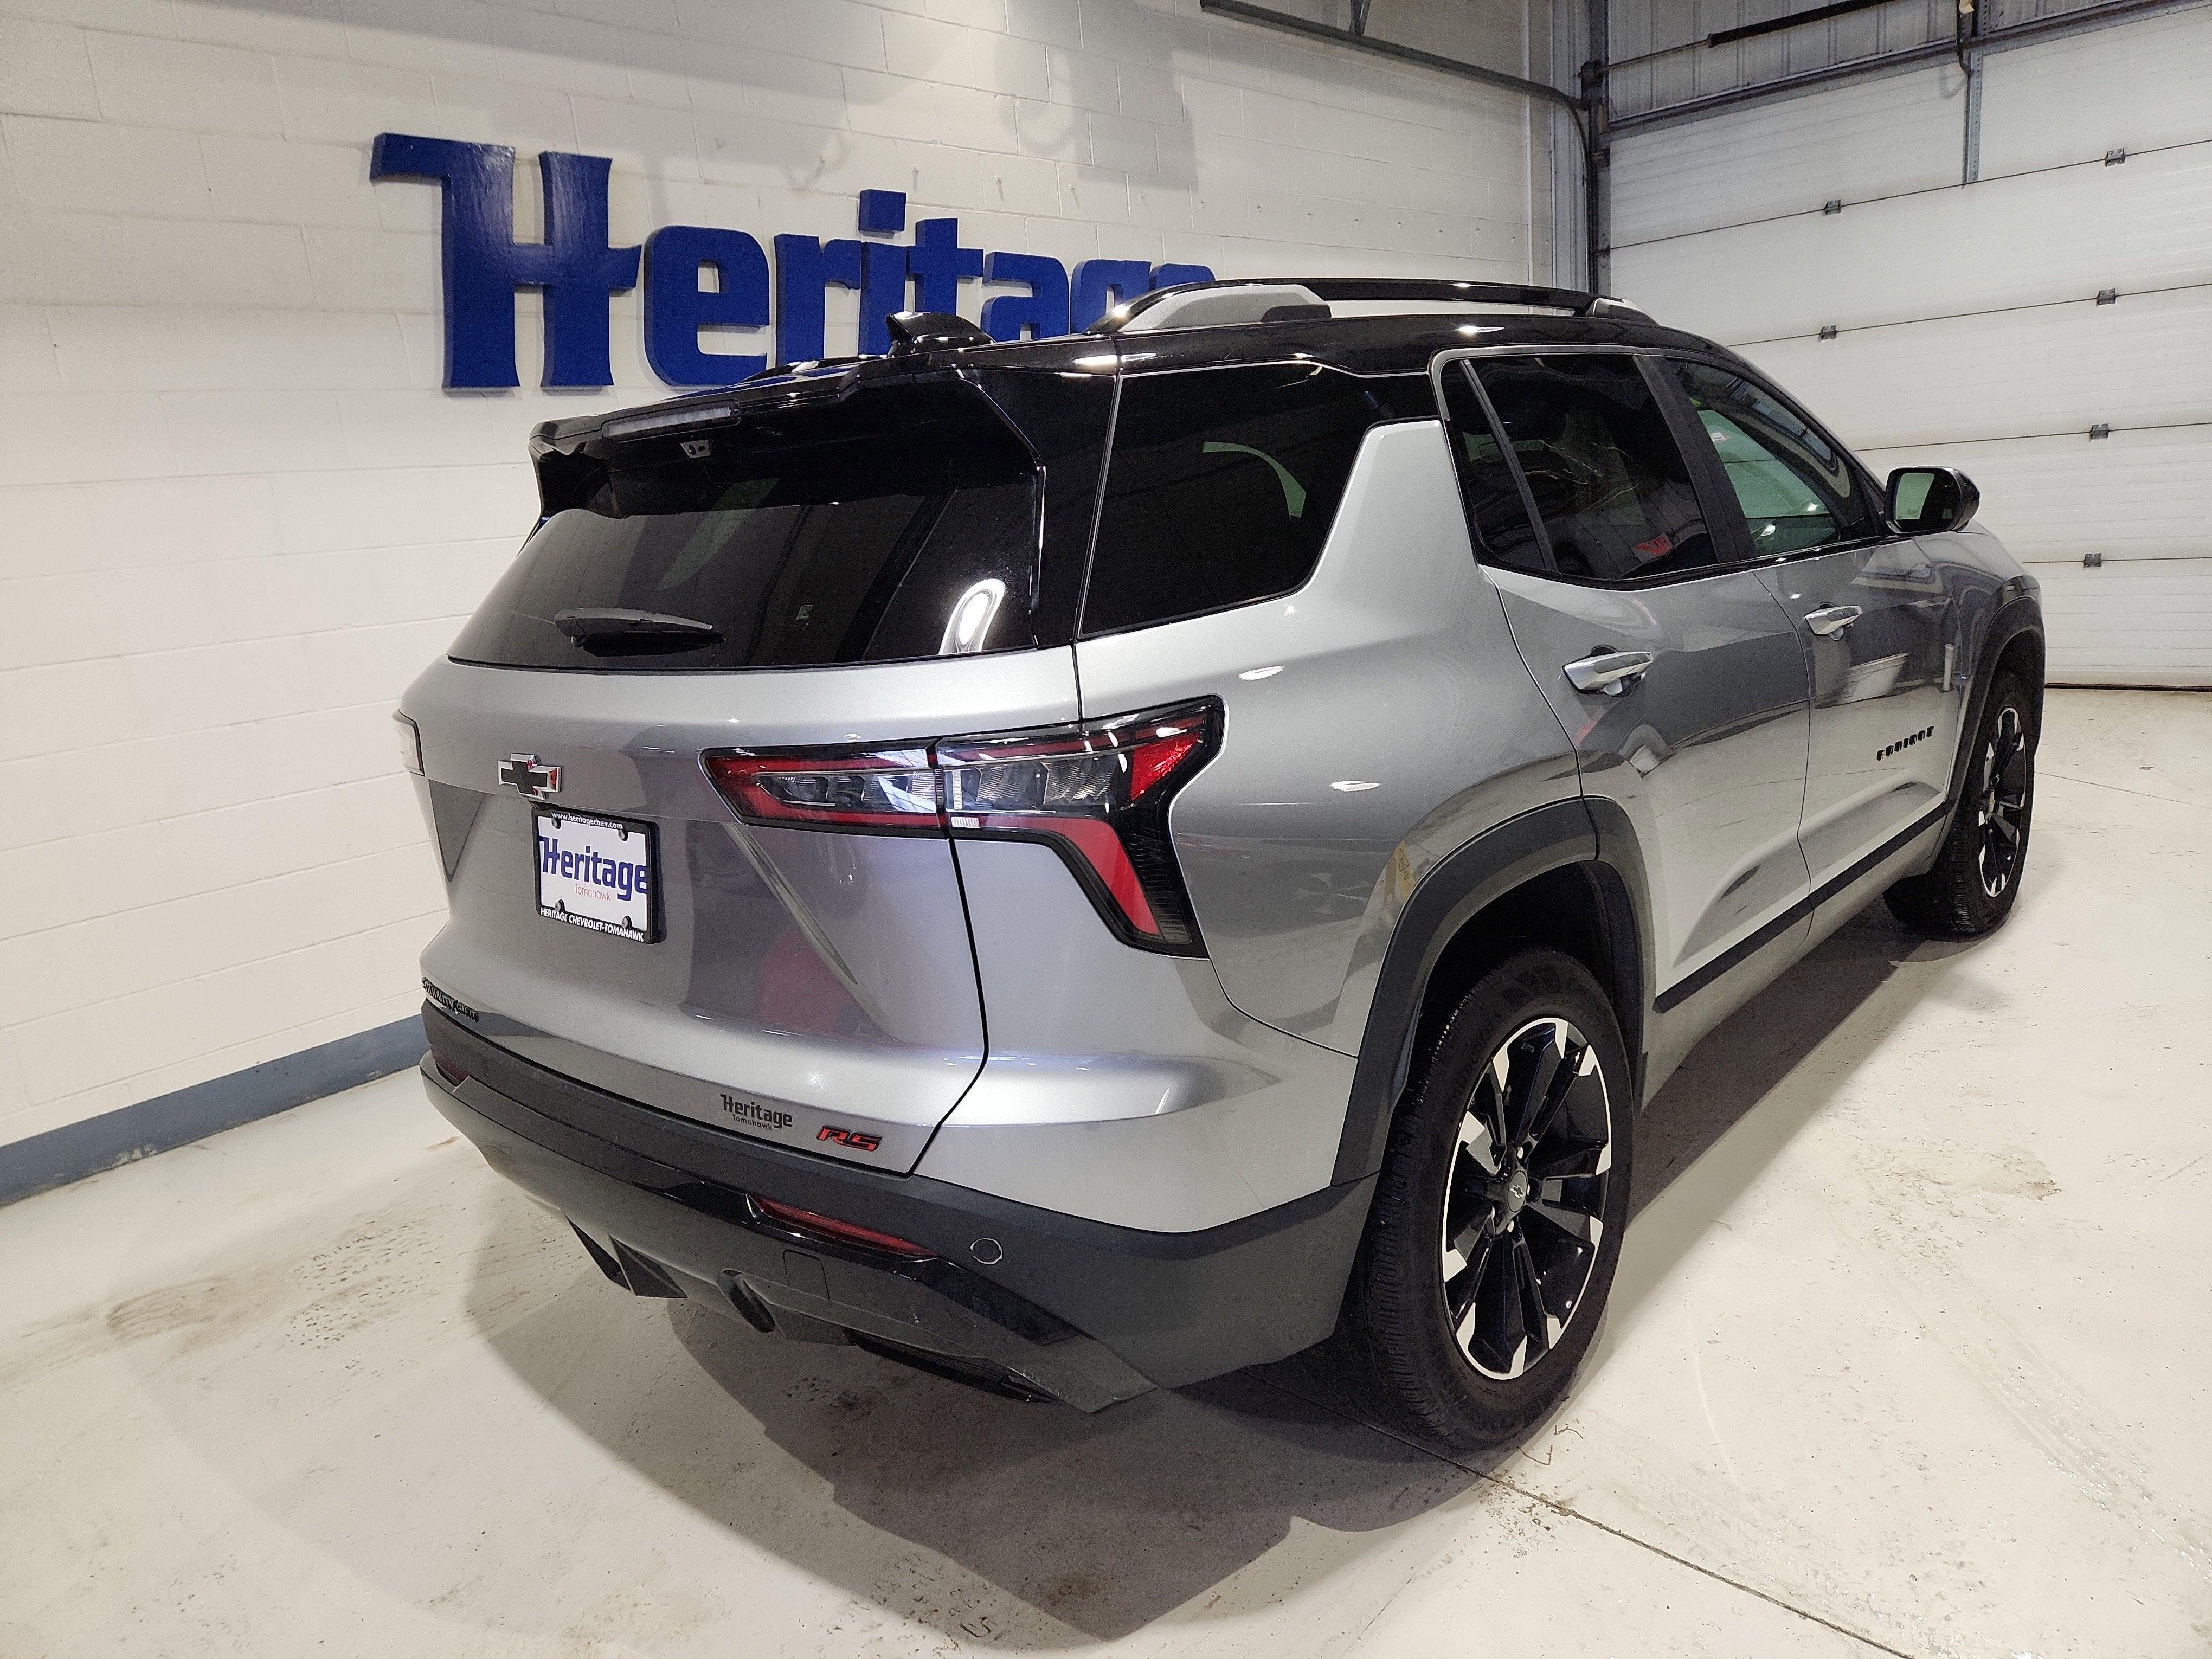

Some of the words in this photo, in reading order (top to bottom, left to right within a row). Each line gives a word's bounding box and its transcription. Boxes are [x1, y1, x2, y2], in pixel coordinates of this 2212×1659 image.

[551, 812, 623, 830] www.heritagechev.com
[538, 835, 647, 902] Heritage
[574, 883, 610, 902] Tomahawk
[541, 907, 568, 922] HERITAGE
[569, 915, 645, 942] CHEVROLET-TOMAHAWK
[720, 1094, 792, 1129] Heritage
[731, 1114, 773, 1131] Tomahawk
[816, 1125, 883, 1152] RS
